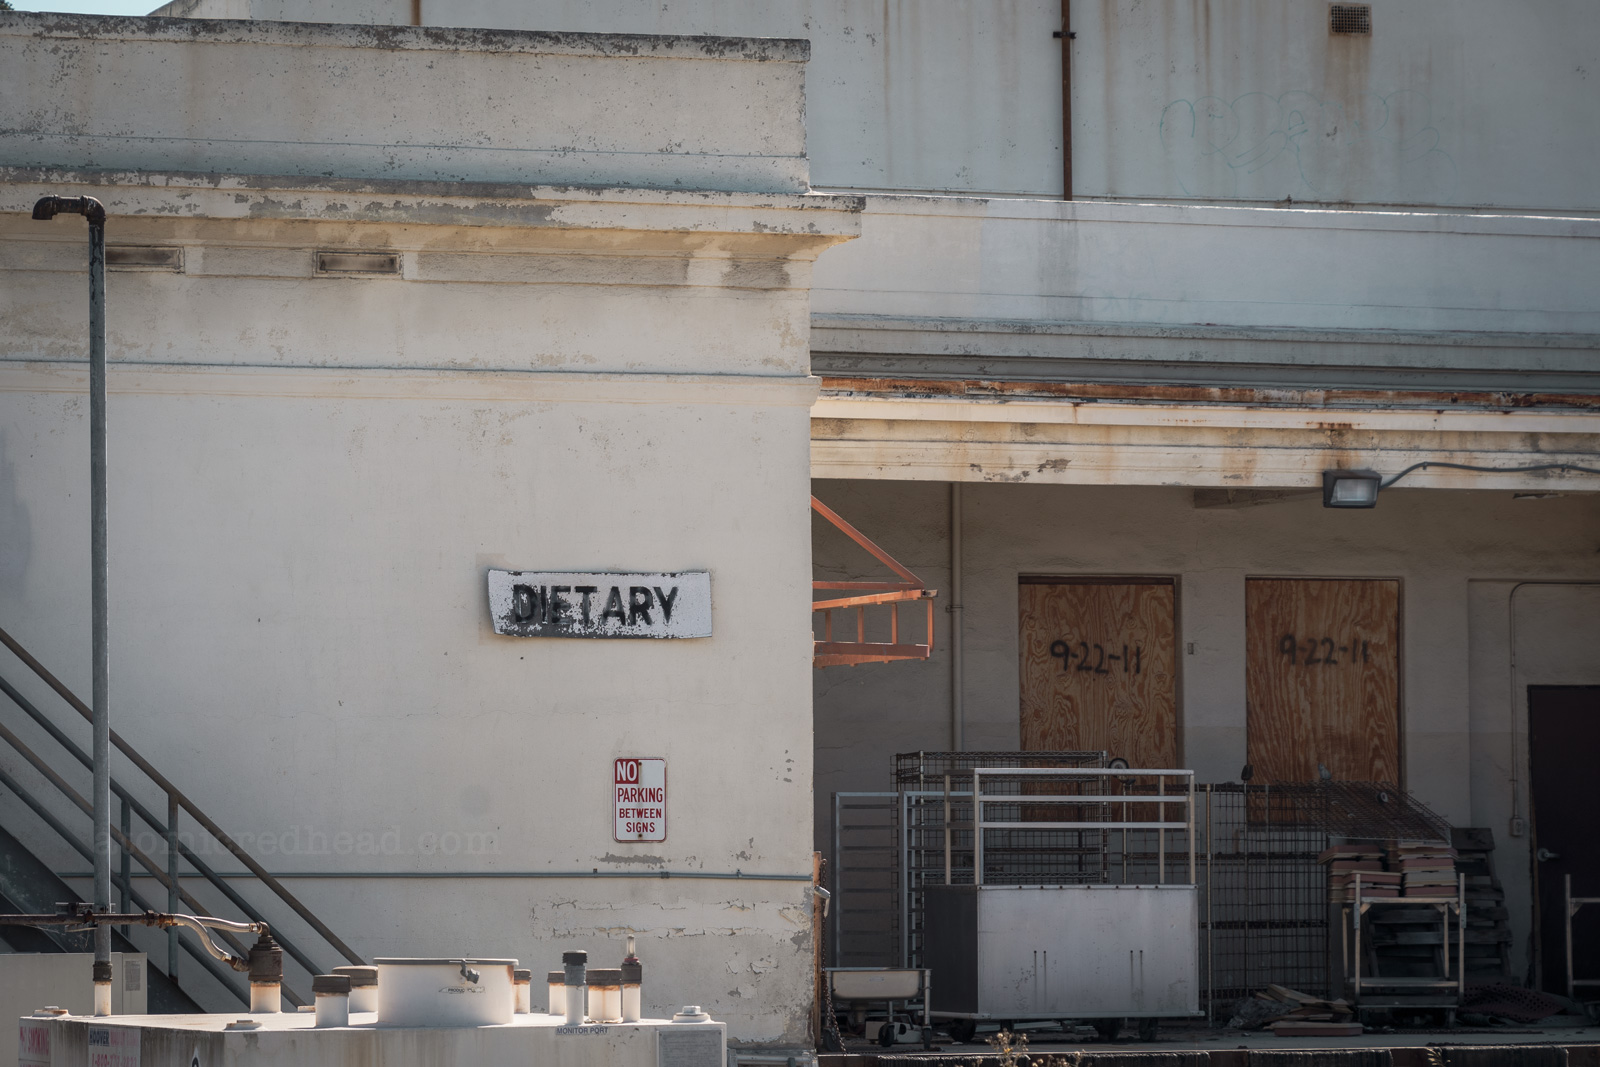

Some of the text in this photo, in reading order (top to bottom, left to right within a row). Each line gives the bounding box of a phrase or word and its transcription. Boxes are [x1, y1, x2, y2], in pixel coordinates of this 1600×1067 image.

[513, 584, 679, 625] DIETARY
[1050, 639, 1140, 674] 9-22-11
[1279, 633, 1369, 665] 9-22-11
[616, 761, 638, 782] NO
[617, 787, 663, 803] PARKING
[619, 808, 662, 819] BETWEEN
[626, 821, 655, 833] SIGNS
[556, 1026, 608, 1035] MONITOR PORT
